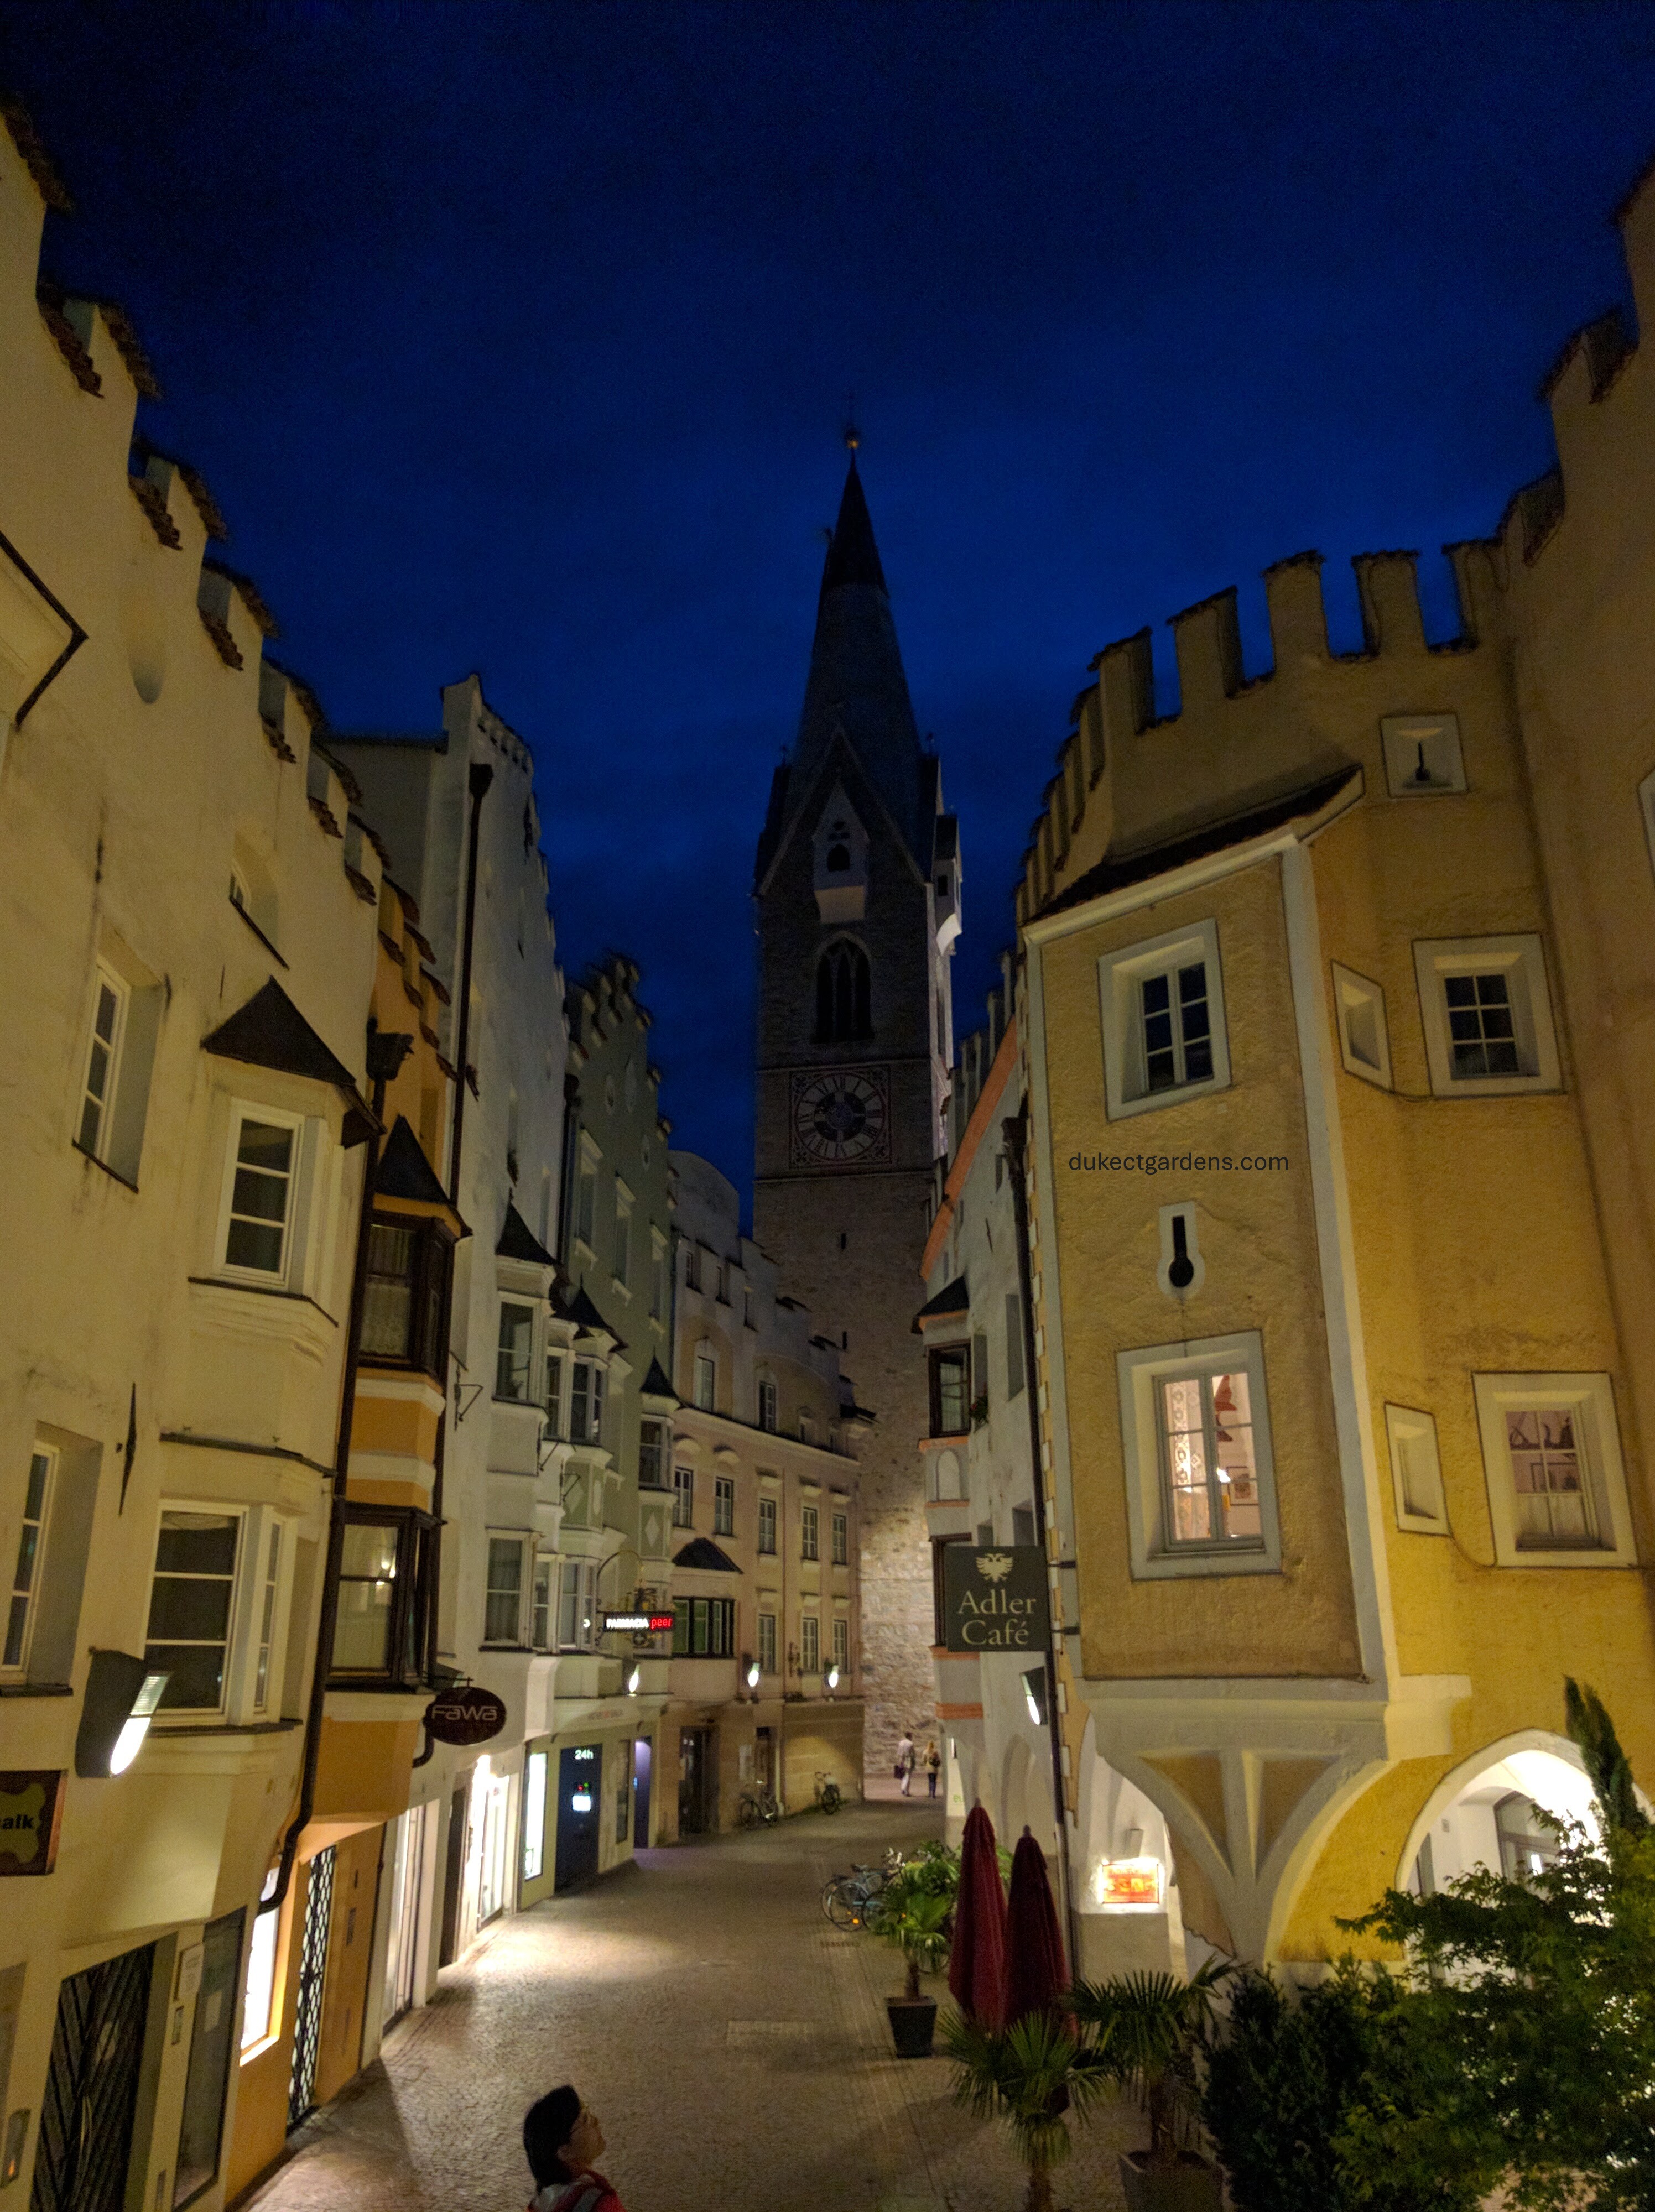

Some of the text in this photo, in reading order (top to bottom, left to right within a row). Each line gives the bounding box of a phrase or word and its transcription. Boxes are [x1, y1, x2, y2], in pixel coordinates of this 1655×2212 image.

[957, 1589, 1037, 1615] Adler
[651, 1618, 673, 1630] peer
[961, 1618, 1029, 1646] Café
[574, 1749, 594, 1760] 24h
[0, 1814, 33, 1829] alk
